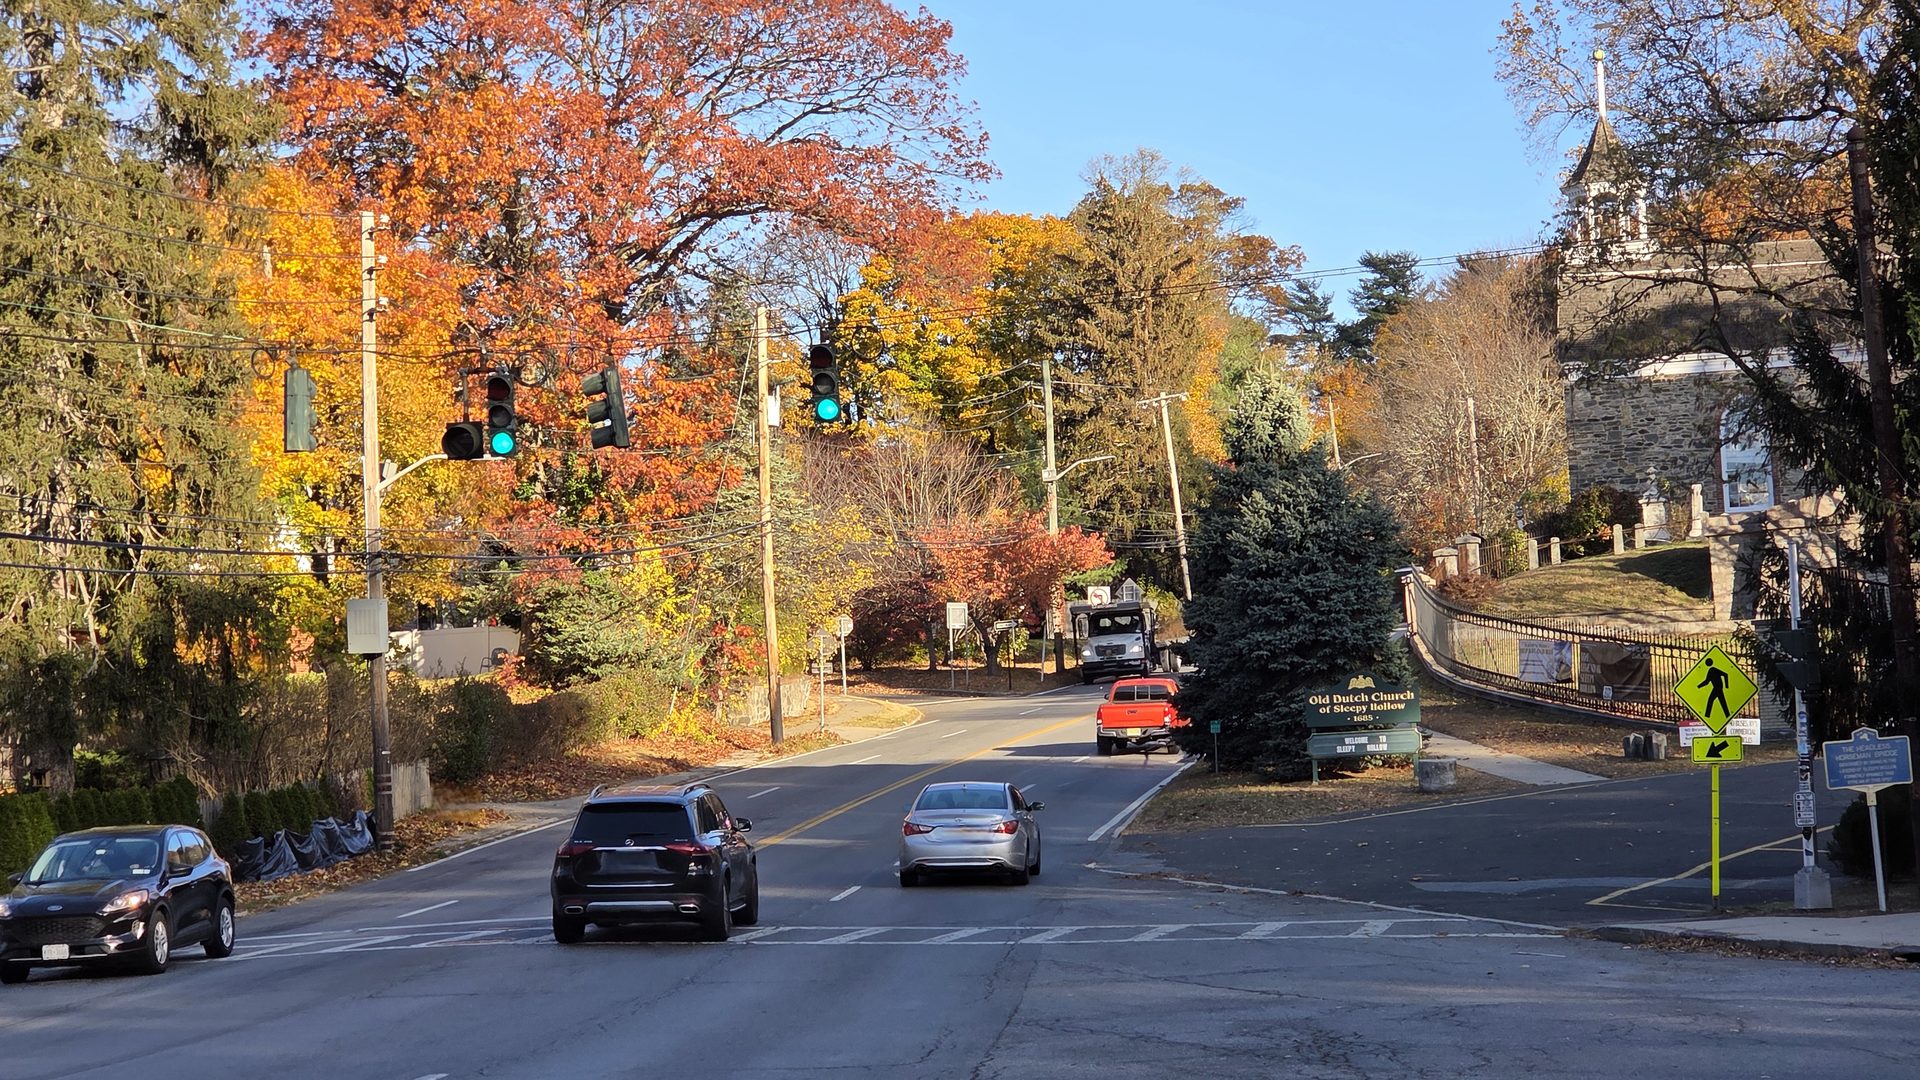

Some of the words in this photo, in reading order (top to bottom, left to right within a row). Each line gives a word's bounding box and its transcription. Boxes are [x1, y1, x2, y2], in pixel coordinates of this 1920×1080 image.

[1309, 694, 1330, 704] Old
[1333, 692, 1368, 704] Dutch
[1372, 690, 1414, 702] Church
[1319, 705, 1331, 714] of
[1334, 704, 1368, 714] Sleepy
[1370, 702, 1406, 711] Hollow
[1353, 714, 1374, 722] 1685
[1344, 736, 1369, 744] WELCOME
[1379, 735, 1387, 743] TO
[1336, 745, 1356, 753] SLEEPY
[1856, 743, 1891, 752] HEADLESS
[1835, 753, 1871, 761] HORSEMAN
[1874, 750, 1898, 758] BRIDGE
